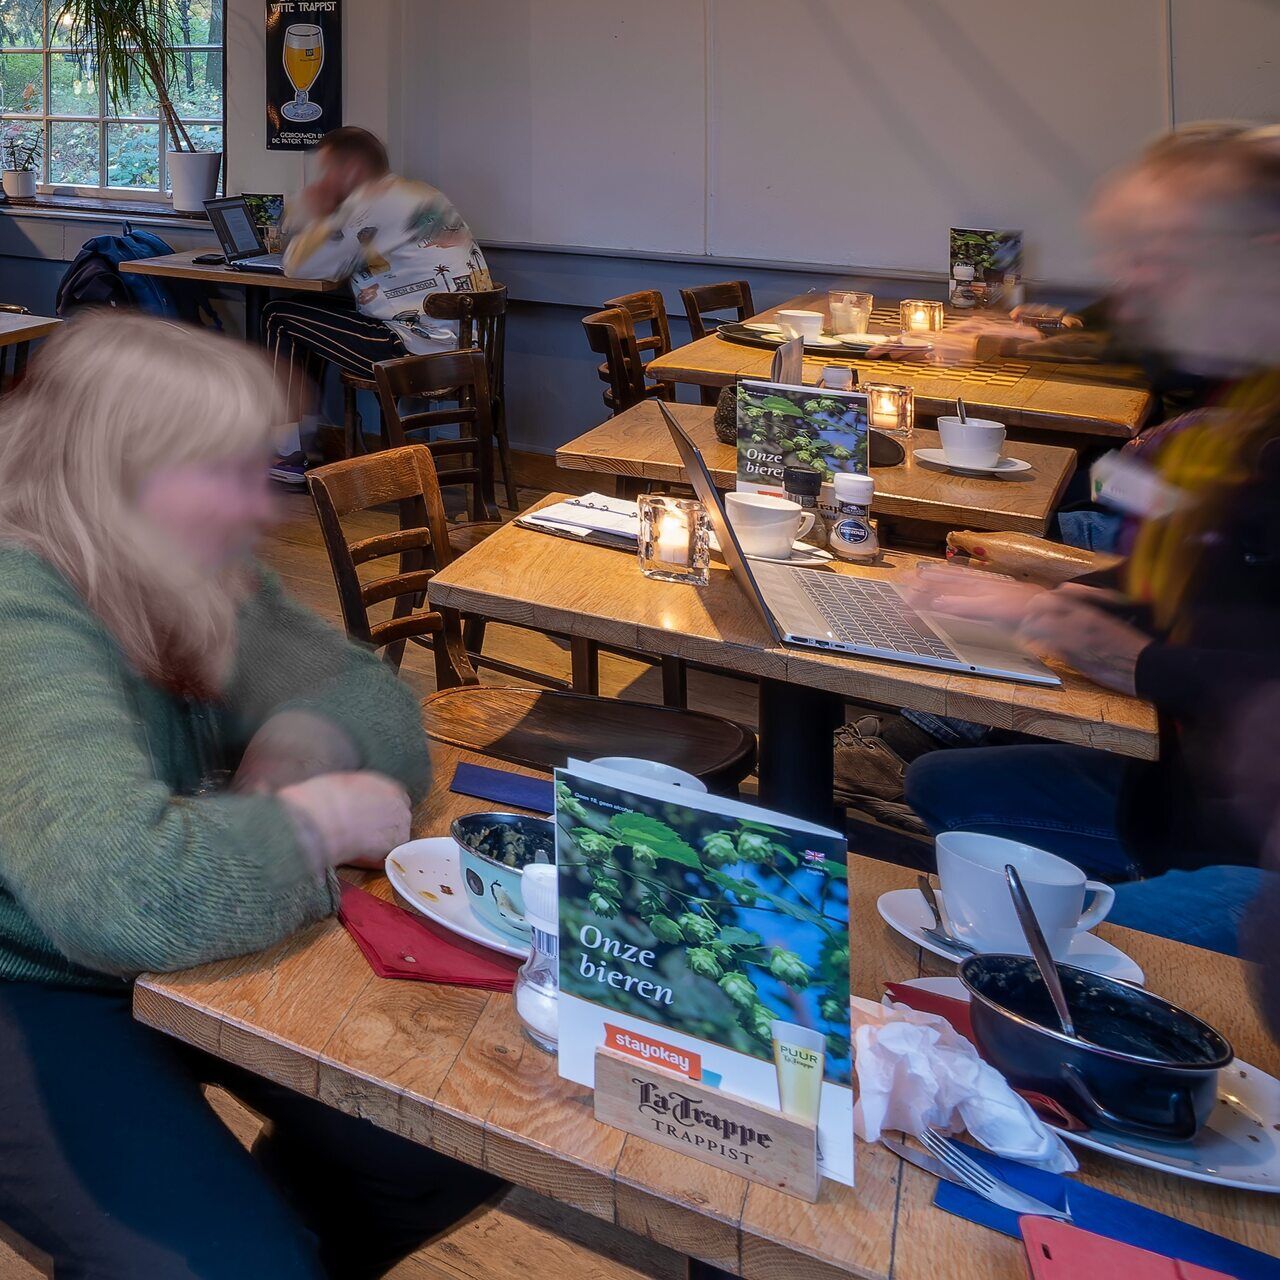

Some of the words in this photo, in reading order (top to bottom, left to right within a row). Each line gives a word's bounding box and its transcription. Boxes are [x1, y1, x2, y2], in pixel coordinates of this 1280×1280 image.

[270, 2, 295, 13] WITTE
[299, 1, 337, 12] TRAPPIST
[746, 448, 783, 464] Onze
[598, 800, 613, 808] geen
[613, 803, 634, 814] alcohol
[578, 923, 657, 969] Onze
[578, 952, 676, 1007] bieren
[614, 1030, 690, 1073] stayokay
[780, 1045, 818, 1064] PUUR
[631, 1076, 671, 1118] La
[669, 1091, 774, 1151] Trappe
[650, 1117, 755, 1167] TRAPPIST
